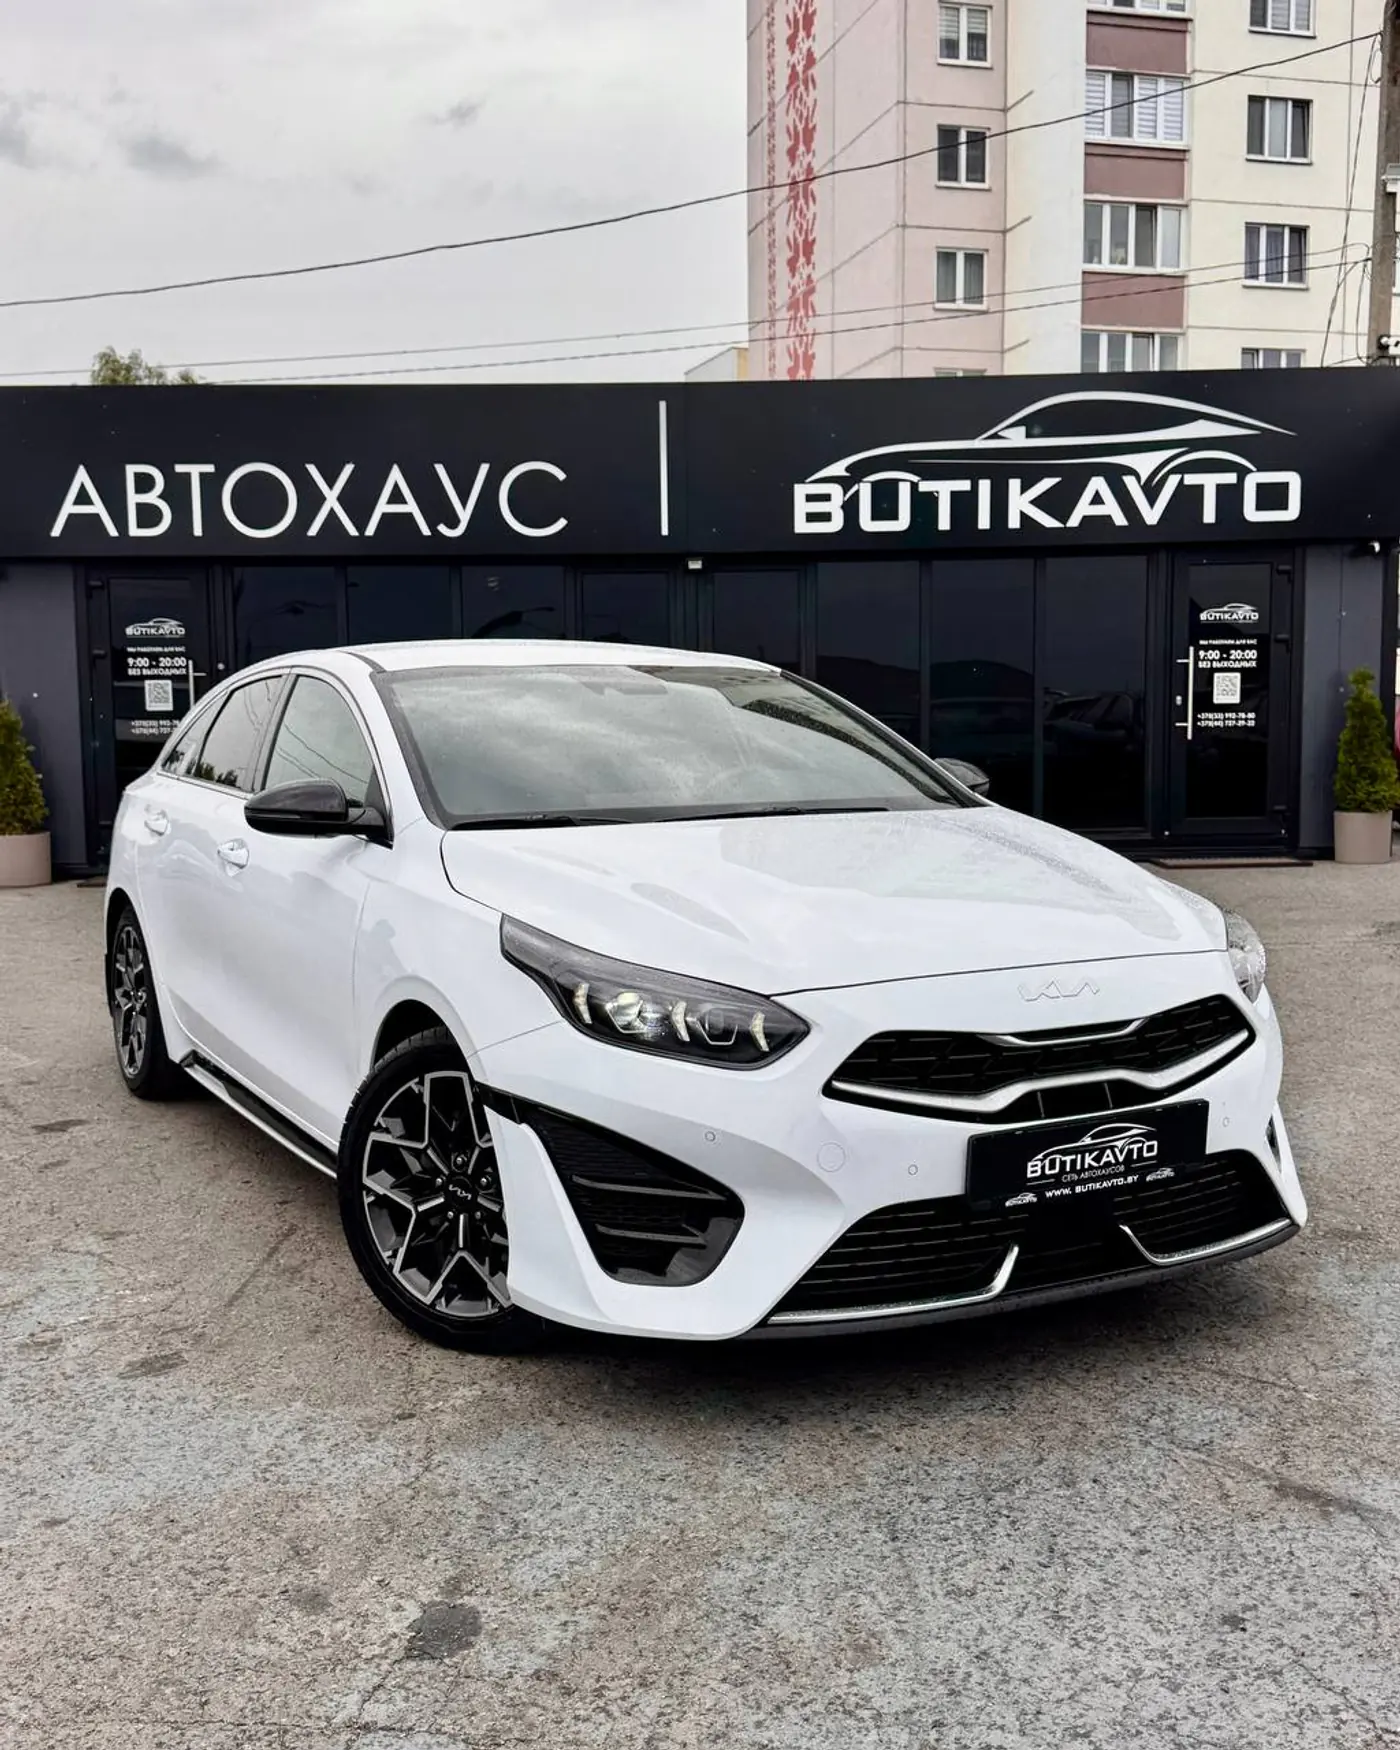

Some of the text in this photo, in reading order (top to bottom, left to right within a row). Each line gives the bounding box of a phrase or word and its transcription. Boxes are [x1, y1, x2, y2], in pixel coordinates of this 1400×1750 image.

[50, 461, 568, 539] АВТОХАУС
[794, 471, 1301, 533] BUTIKAVTO
[1199, 611, 1259, 621] BUTIKAVTO
[125, 627, 186, 636] BUTIKAVTO
[127, 656, 149, 667] 9:00
[158, 656, 187, 667] 20:00
[1198, 660, 1257, 668] БЕЗ ВЫХОДНЫХ
[1199, 649, 1220, 660] 9:00
[1229, 649, 1258, 660] 20:00
[1017, 977, 1100, 1001] KIA
[1026, 1140, 1158, 1178] BUTIKAVTO
[1061, 1164, 1125, 1183] СЕТЬ АВТОХАУСОВ
[1045, 1175, 1139, 1198] WWW. BUTIKAVTO.BY
